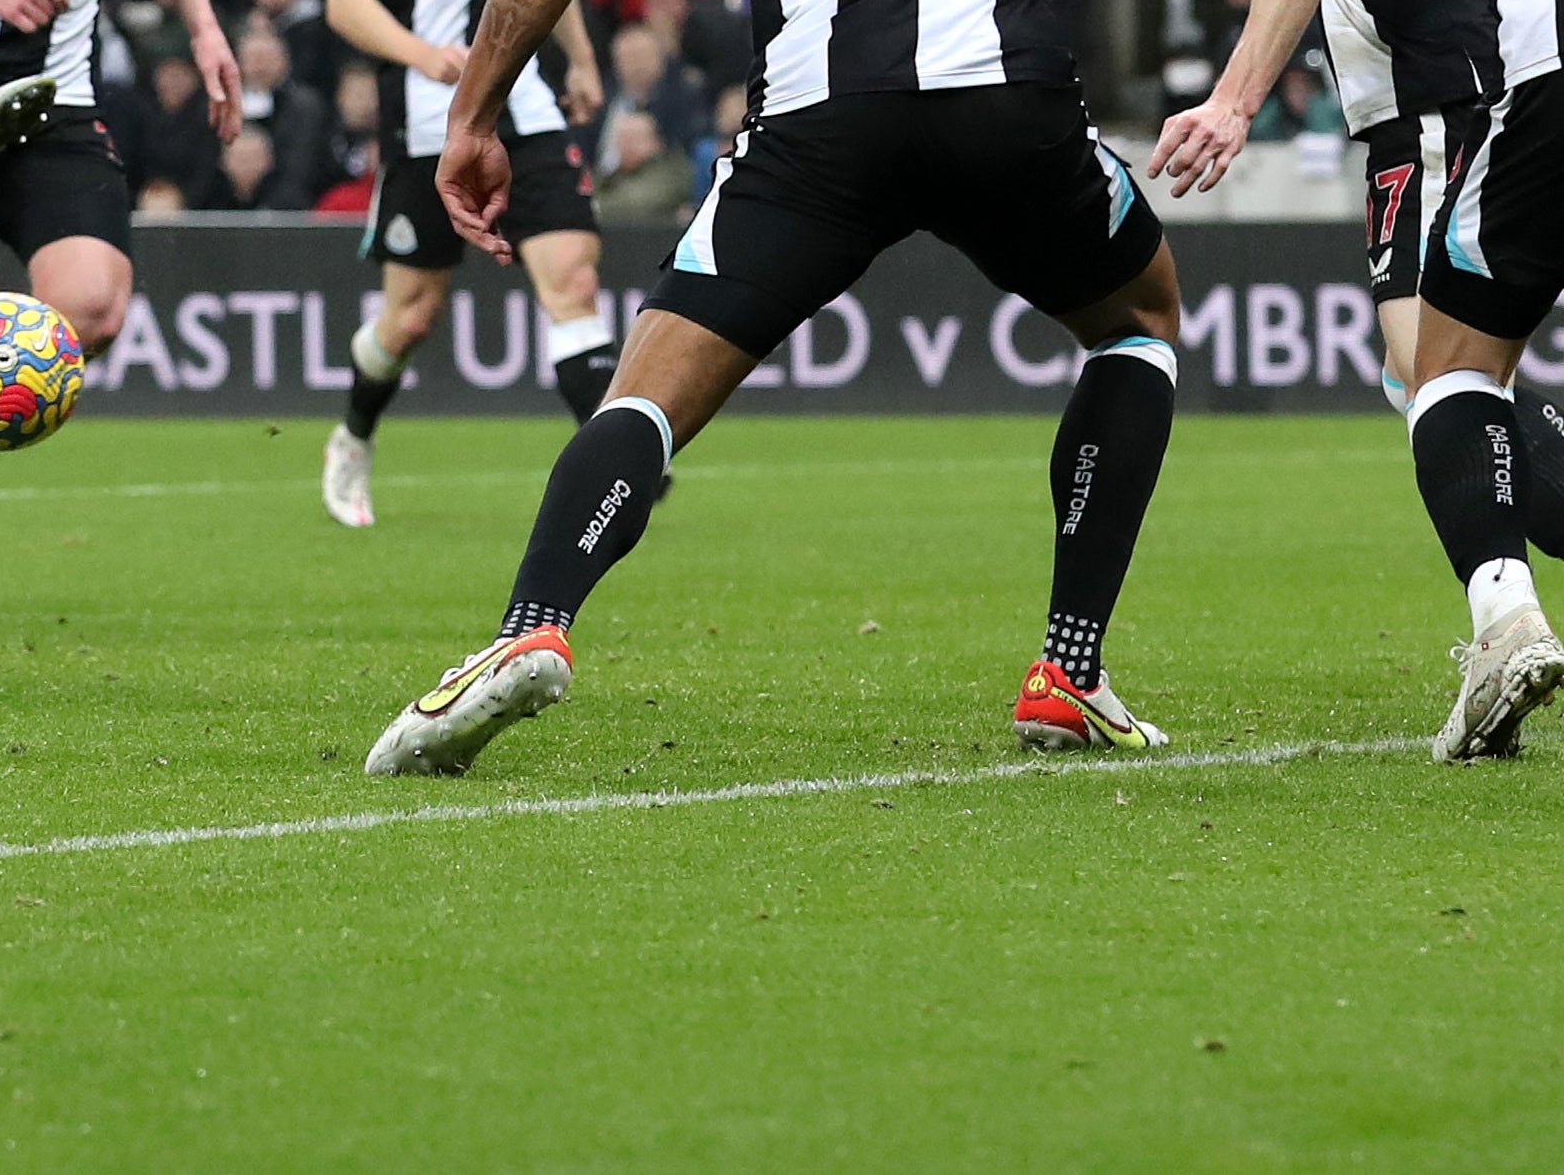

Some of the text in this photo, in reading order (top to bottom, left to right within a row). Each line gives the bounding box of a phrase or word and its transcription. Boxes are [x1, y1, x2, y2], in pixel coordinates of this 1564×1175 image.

[899, 315, 963, 388] v
[1062, 444, 1099, 535] CASTORE
[1485, 424, 1514, 506] CASTORE
[577, 478, 632, 555] CASTORE
